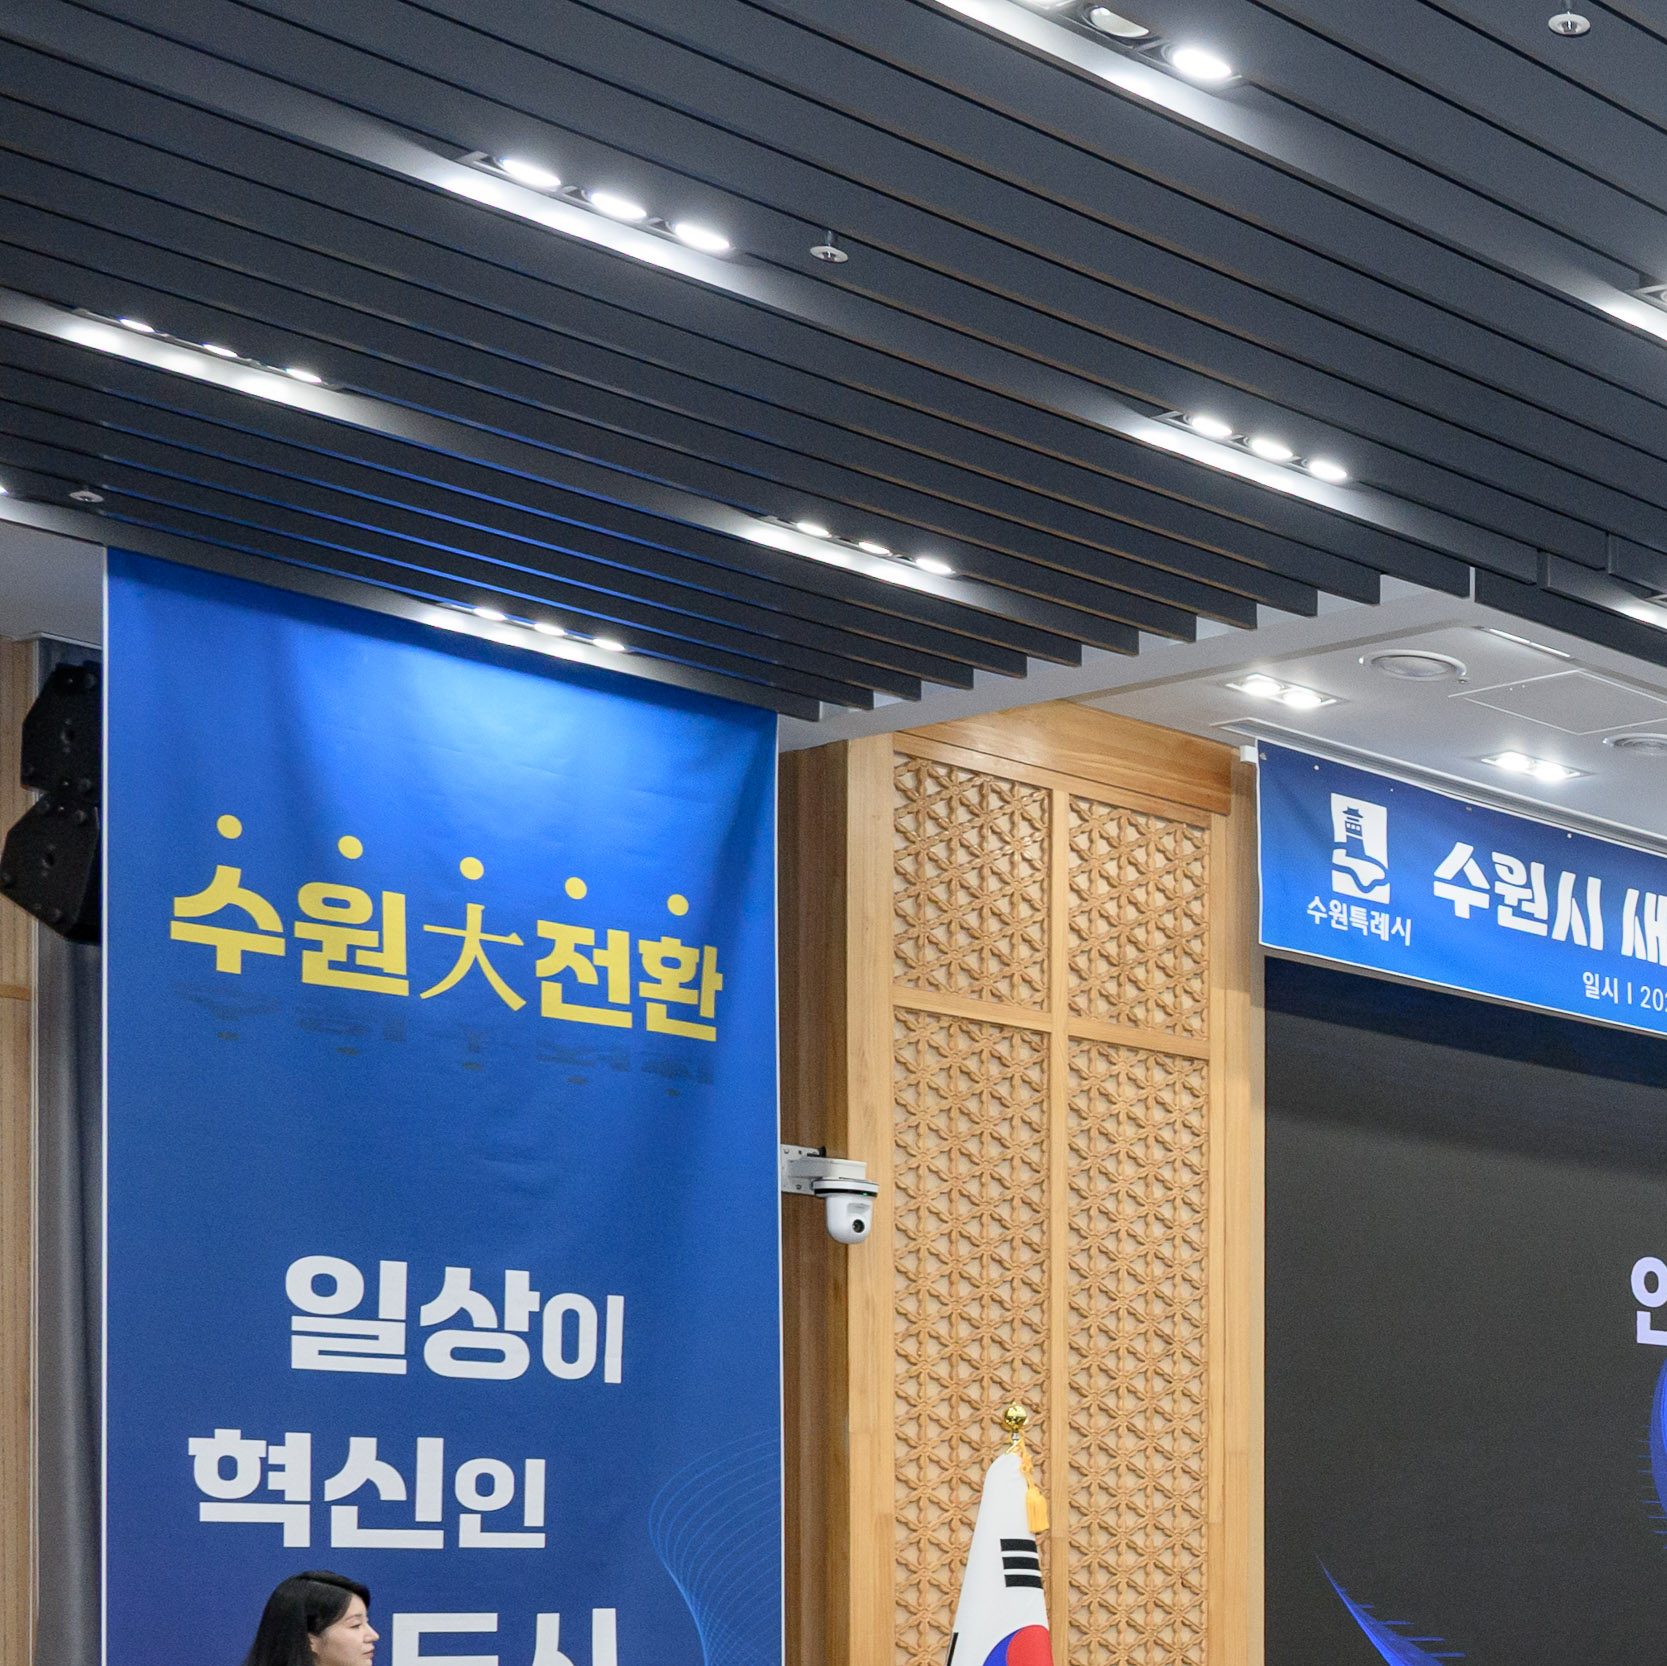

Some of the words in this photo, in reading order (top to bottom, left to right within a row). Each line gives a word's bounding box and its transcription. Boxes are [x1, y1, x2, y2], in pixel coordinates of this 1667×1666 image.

[1306, 894, 1413, 947] 수원특례시
[1432, 841, 1604, 951] 수원시
[1581, 971, 1620, 1005] 일시
[284, 1254, 625, 1384] 일상이
[187, 1428, 547, 1549] 혁신인
